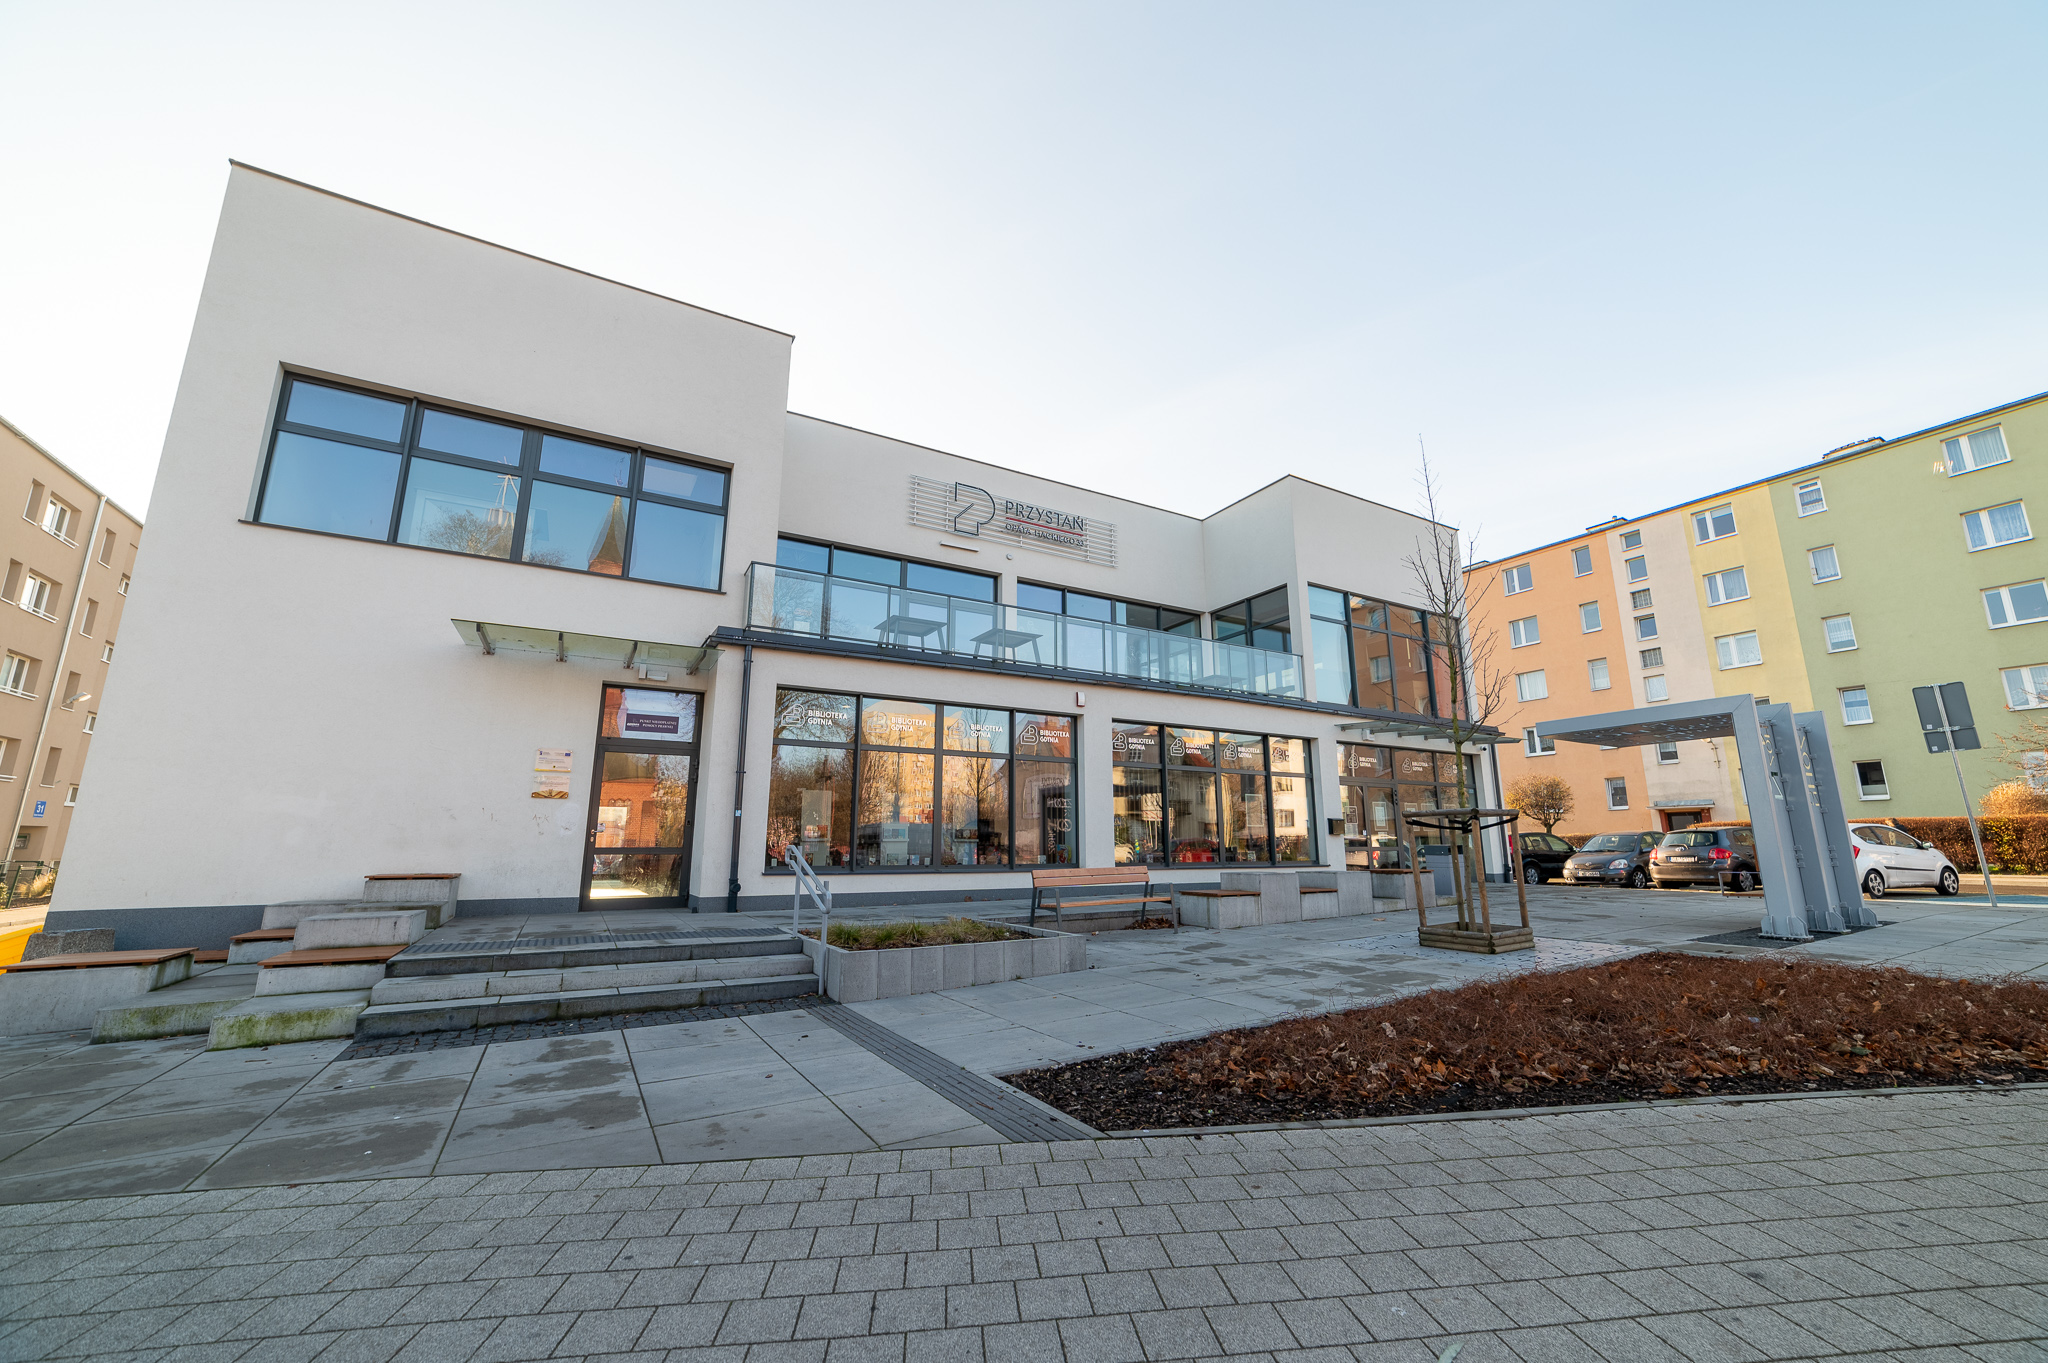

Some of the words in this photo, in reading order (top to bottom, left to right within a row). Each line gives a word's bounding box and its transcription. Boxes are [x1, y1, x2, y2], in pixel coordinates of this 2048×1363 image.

[1005, 500, 1084, 532] PRZYSTAŃ
[1005, 523, 1032, 536] OPATA
[808, 709, 848, 720] BIBLIOTEKA
[807, 717, 833, 726] GDYNIA
[891, 716, 927, 726] BIBLIOTEKA
[890, 724, 914, 732] GDYNIA
[970, 723, 1003, 732] BIBLIOTEKA
[1039, 729, 1070, 738] BIBLIOTEKA
[1128, 737, 1155, 745] BIBLIOTEKA
